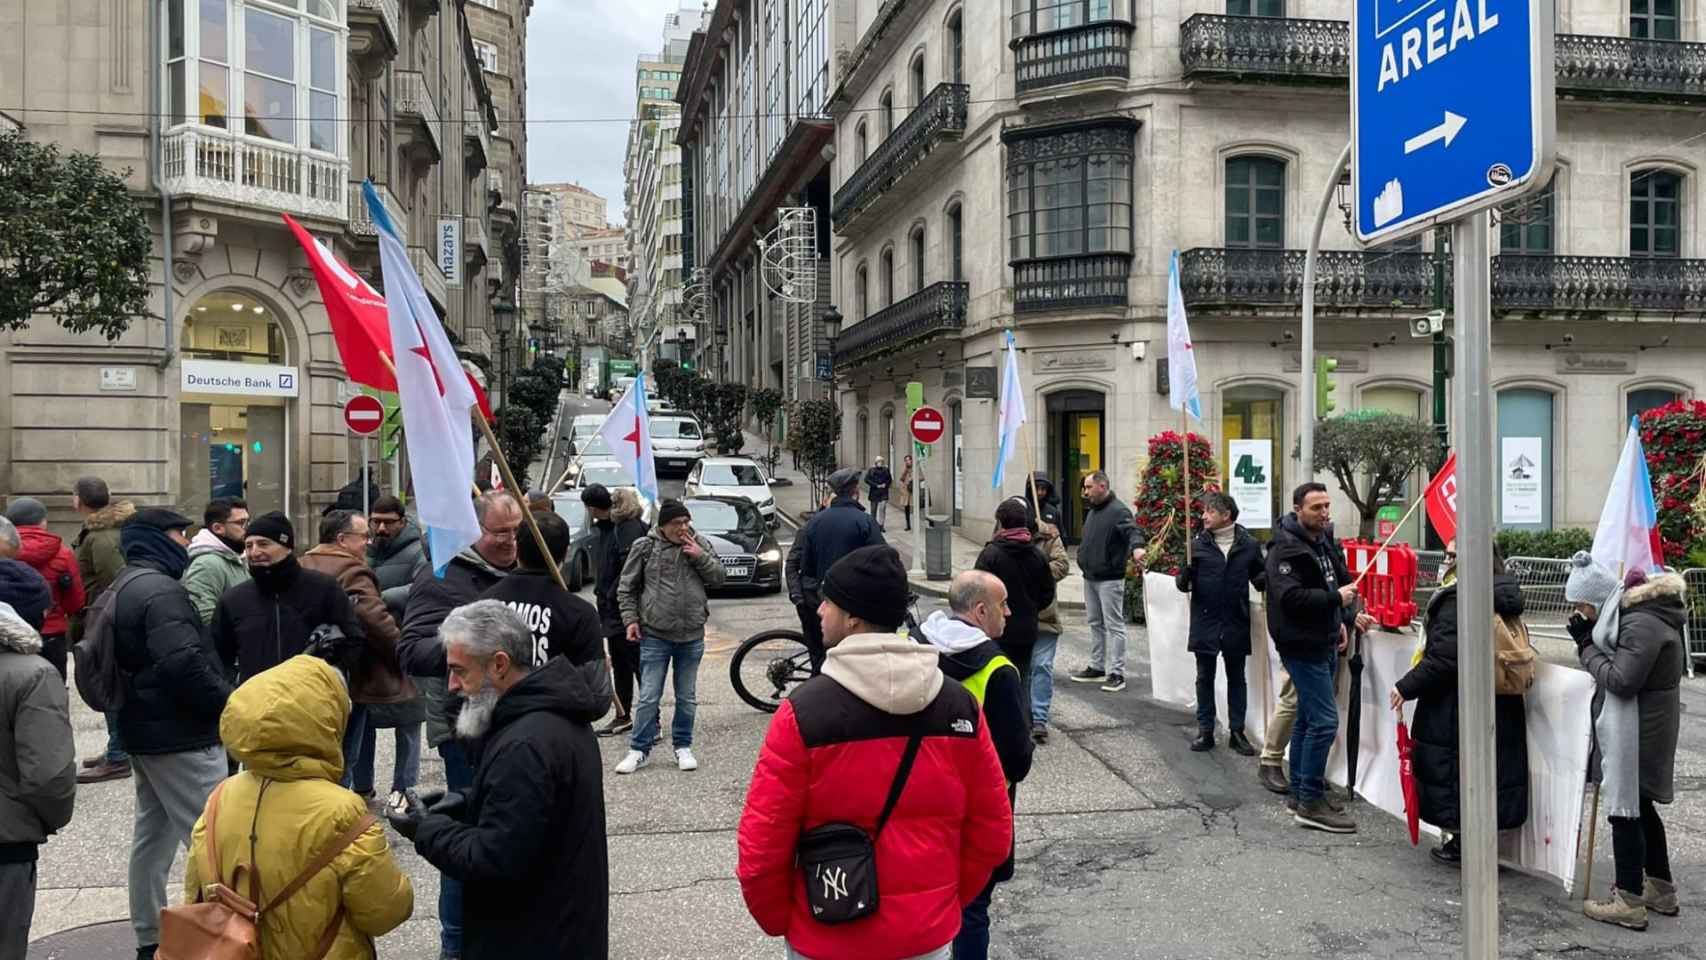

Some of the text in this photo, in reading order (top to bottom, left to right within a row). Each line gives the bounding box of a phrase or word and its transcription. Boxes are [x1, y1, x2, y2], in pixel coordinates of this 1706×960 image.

[1377, 0, 1499, 92] AREAL
[443, 224, 454, 280] mazars
[187, 374, 272, 389] Deutsche Bank
[1234, 454, 1266, 484] 4%
